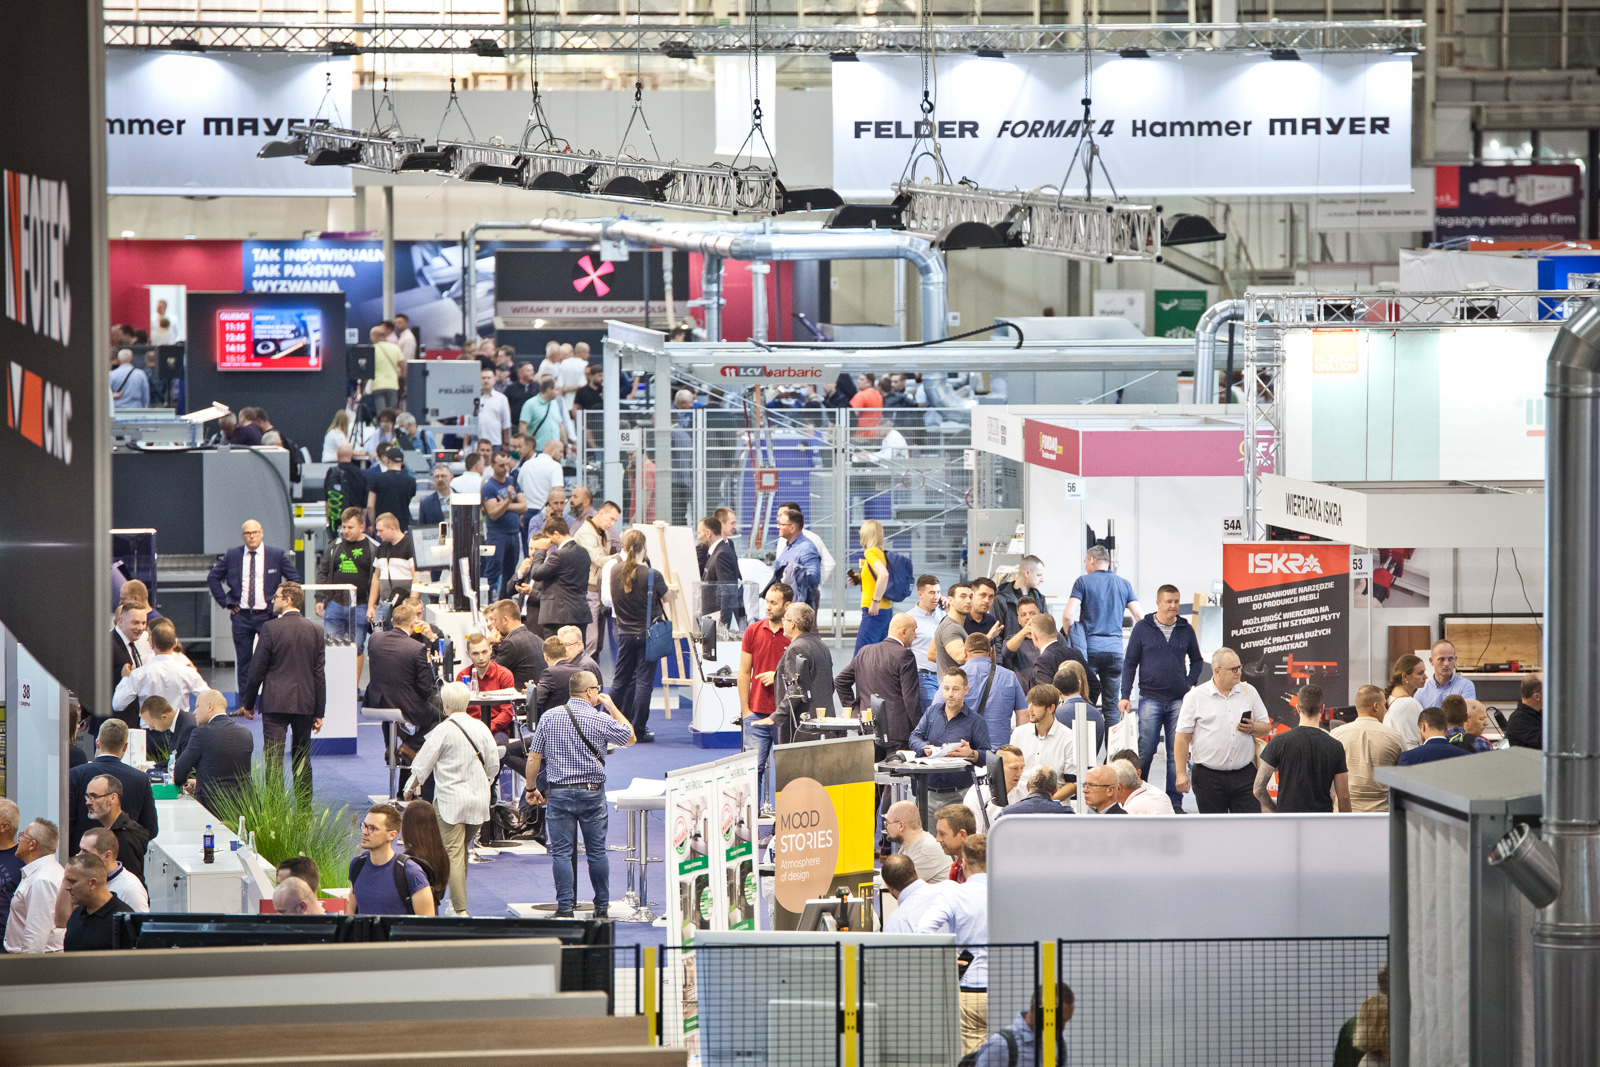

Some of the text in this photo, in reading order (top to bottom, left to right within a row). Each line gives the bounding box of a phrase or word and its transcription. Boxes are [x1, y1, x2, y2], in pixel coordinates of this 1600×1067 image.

[854, 120, 979, 138] FELDER
[1132, 119, 1252, 137] Hammer
[1269, 116, 1390, 136] MAYER
[1488, 214, 1529, 228] energii
[1530, 213, 1549, 225] dla
[1550, 213, 1576, 225] firm
[252, 248, 281, 262] TAK
[252, 260, 356, 278] JAK PAŃSTWA
[510, 305, 550, 314] WITAMY
[566, 306, 598, 314] FELDER
[602, 306, 636, 314] GROUP
[225, 322, 246, 332] 11:15
[740, 366, 822, 378] LCV barbaric
[620, 432, 630, 442] 68
[1067, 482, 1076, 492] 56
[1286, 492, 1343, 526] WIERTARKA ISKRA
[1224, 520, 1242, 530] 54A
[1352, 558, 1363, 570] 53
[1238, 581, 1335, 604] WIELOZADANIOWE NARZĘDZIE
[1252, 593, 1320, 610] DO PRODUKCJI MEBLI
[1242, 612, 1282, 626] MOŻLIWOŚĆ
[1282, 607, 1319, 620] WIERCENIA
[1231, 623, 1278, 637] PŁASZCZYŹNIE
[1282, 620, 1290, 628] W
[1290, 616, 1320, 627] SZTORCU
[1320, 612, 1341, 622] PŁYTY
[1240, 628, 1331, 650] ŁATWOŚĆ PRACY NA DUŻYCH
[1264, 640, 1308, 654] FORMATKACH
[22, 684, 30, 699] 38
[780, 810, 820, 830] MOOD
[780, 830, 833, 853] STORIES
[780, 856, 820, 870] Atmosphere
[780, 870, 810, 882] of design
